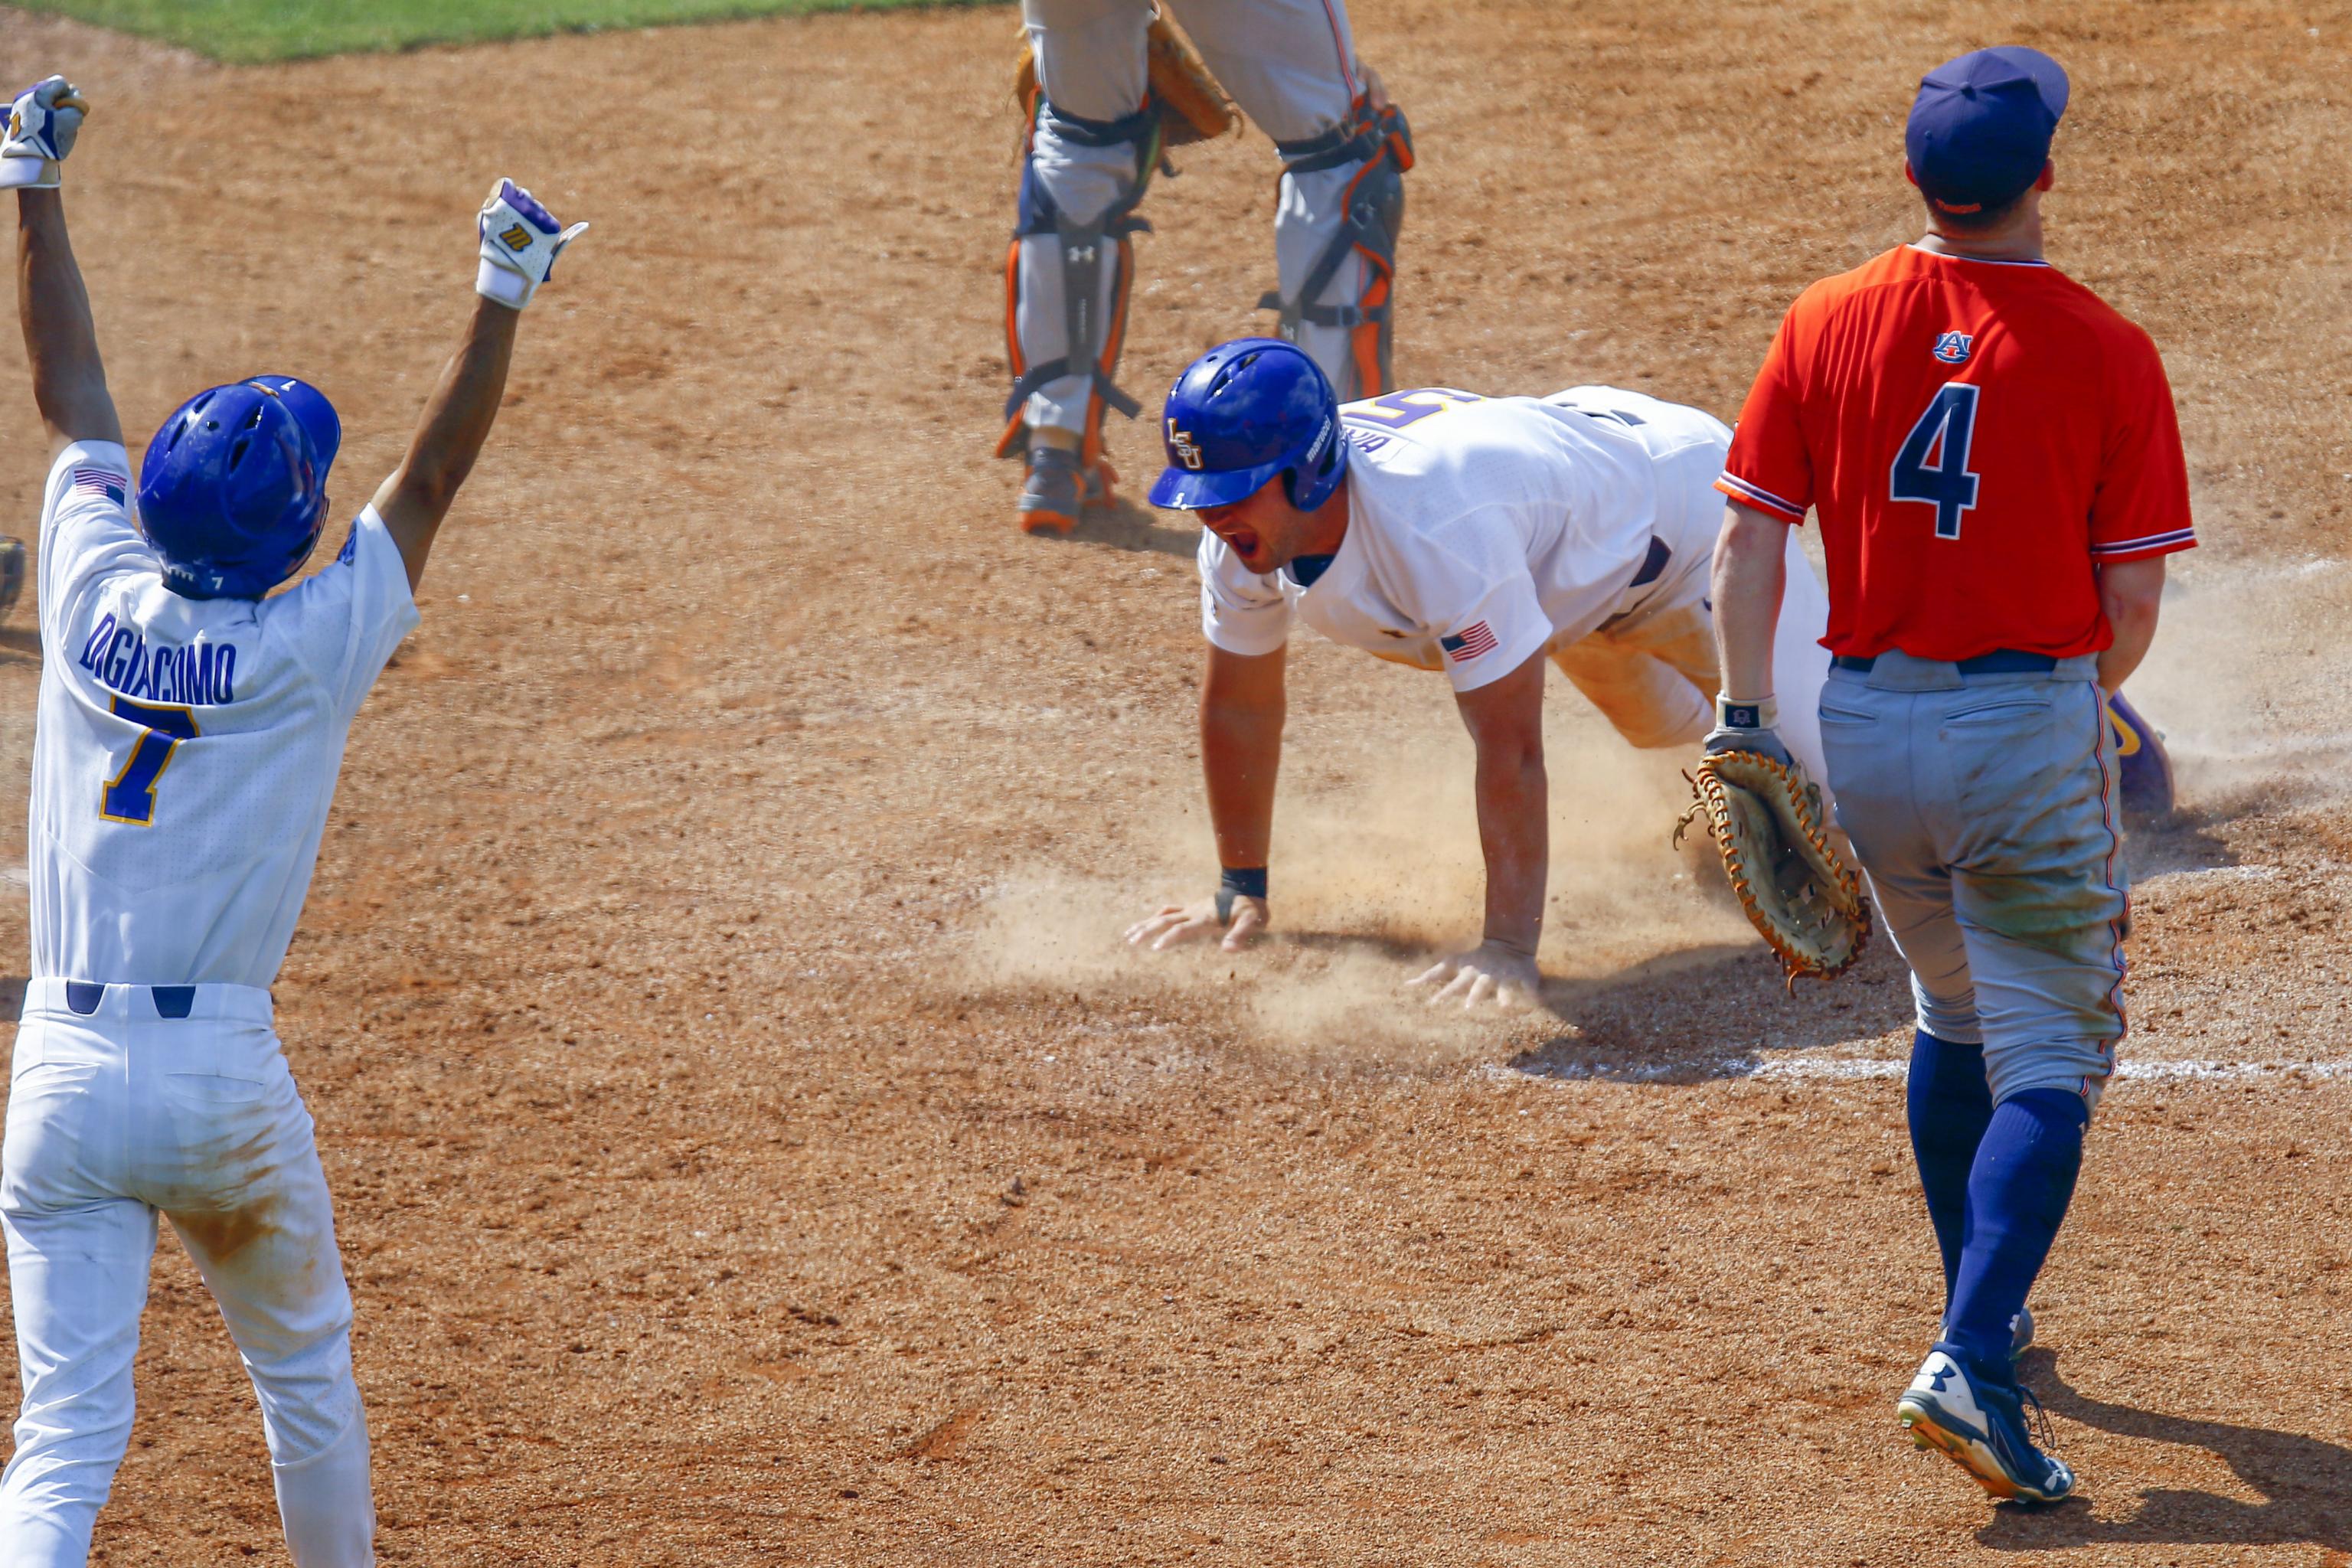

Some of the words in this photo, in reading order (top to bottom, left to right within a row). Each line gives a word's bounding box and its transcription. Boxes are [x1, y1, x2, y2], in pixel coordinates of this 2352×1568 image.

[1168, 417, 1204, 470] LSU
[1305, 414, 1331, 462] marucci
[1889, 381, 1981, 541] 4
[1172, 492, 1185, 507] 5
[211, 576, 224, 591] 7
[99, 694, 201, 827] 7
